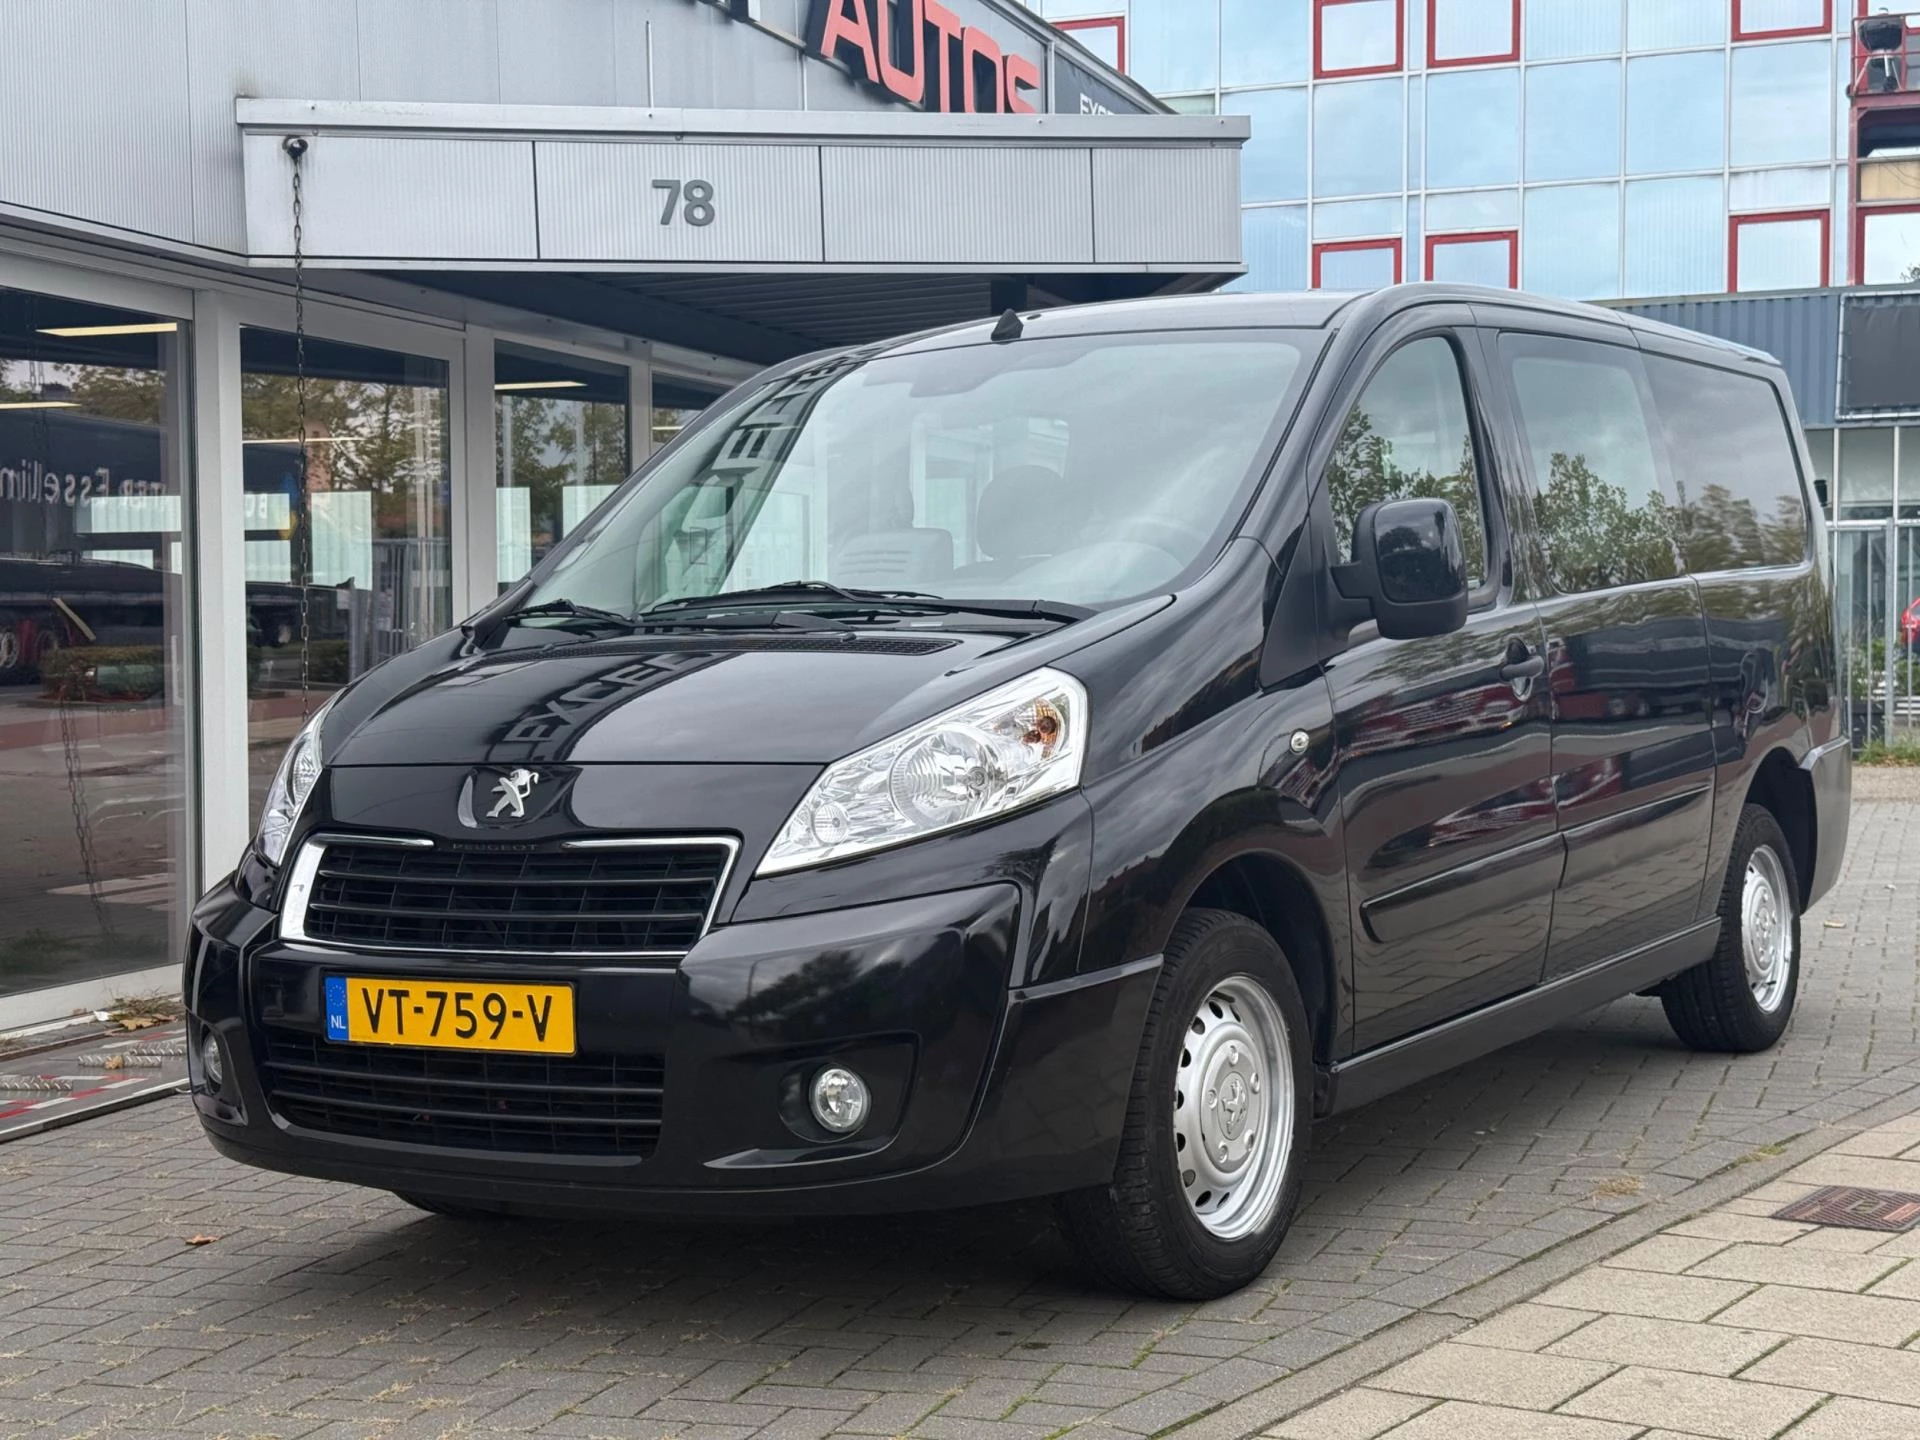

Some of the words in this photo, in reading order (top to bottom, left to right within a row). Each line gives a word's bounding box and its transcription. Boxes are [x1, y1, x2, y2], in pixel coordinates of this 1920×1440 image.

[820, 0, 1040, 113] AUTOS
[652, 179, 715, 226] 78
[330, 1014, 347, 1030] NL
[361, 986, 552, 1042] VT-759-V
